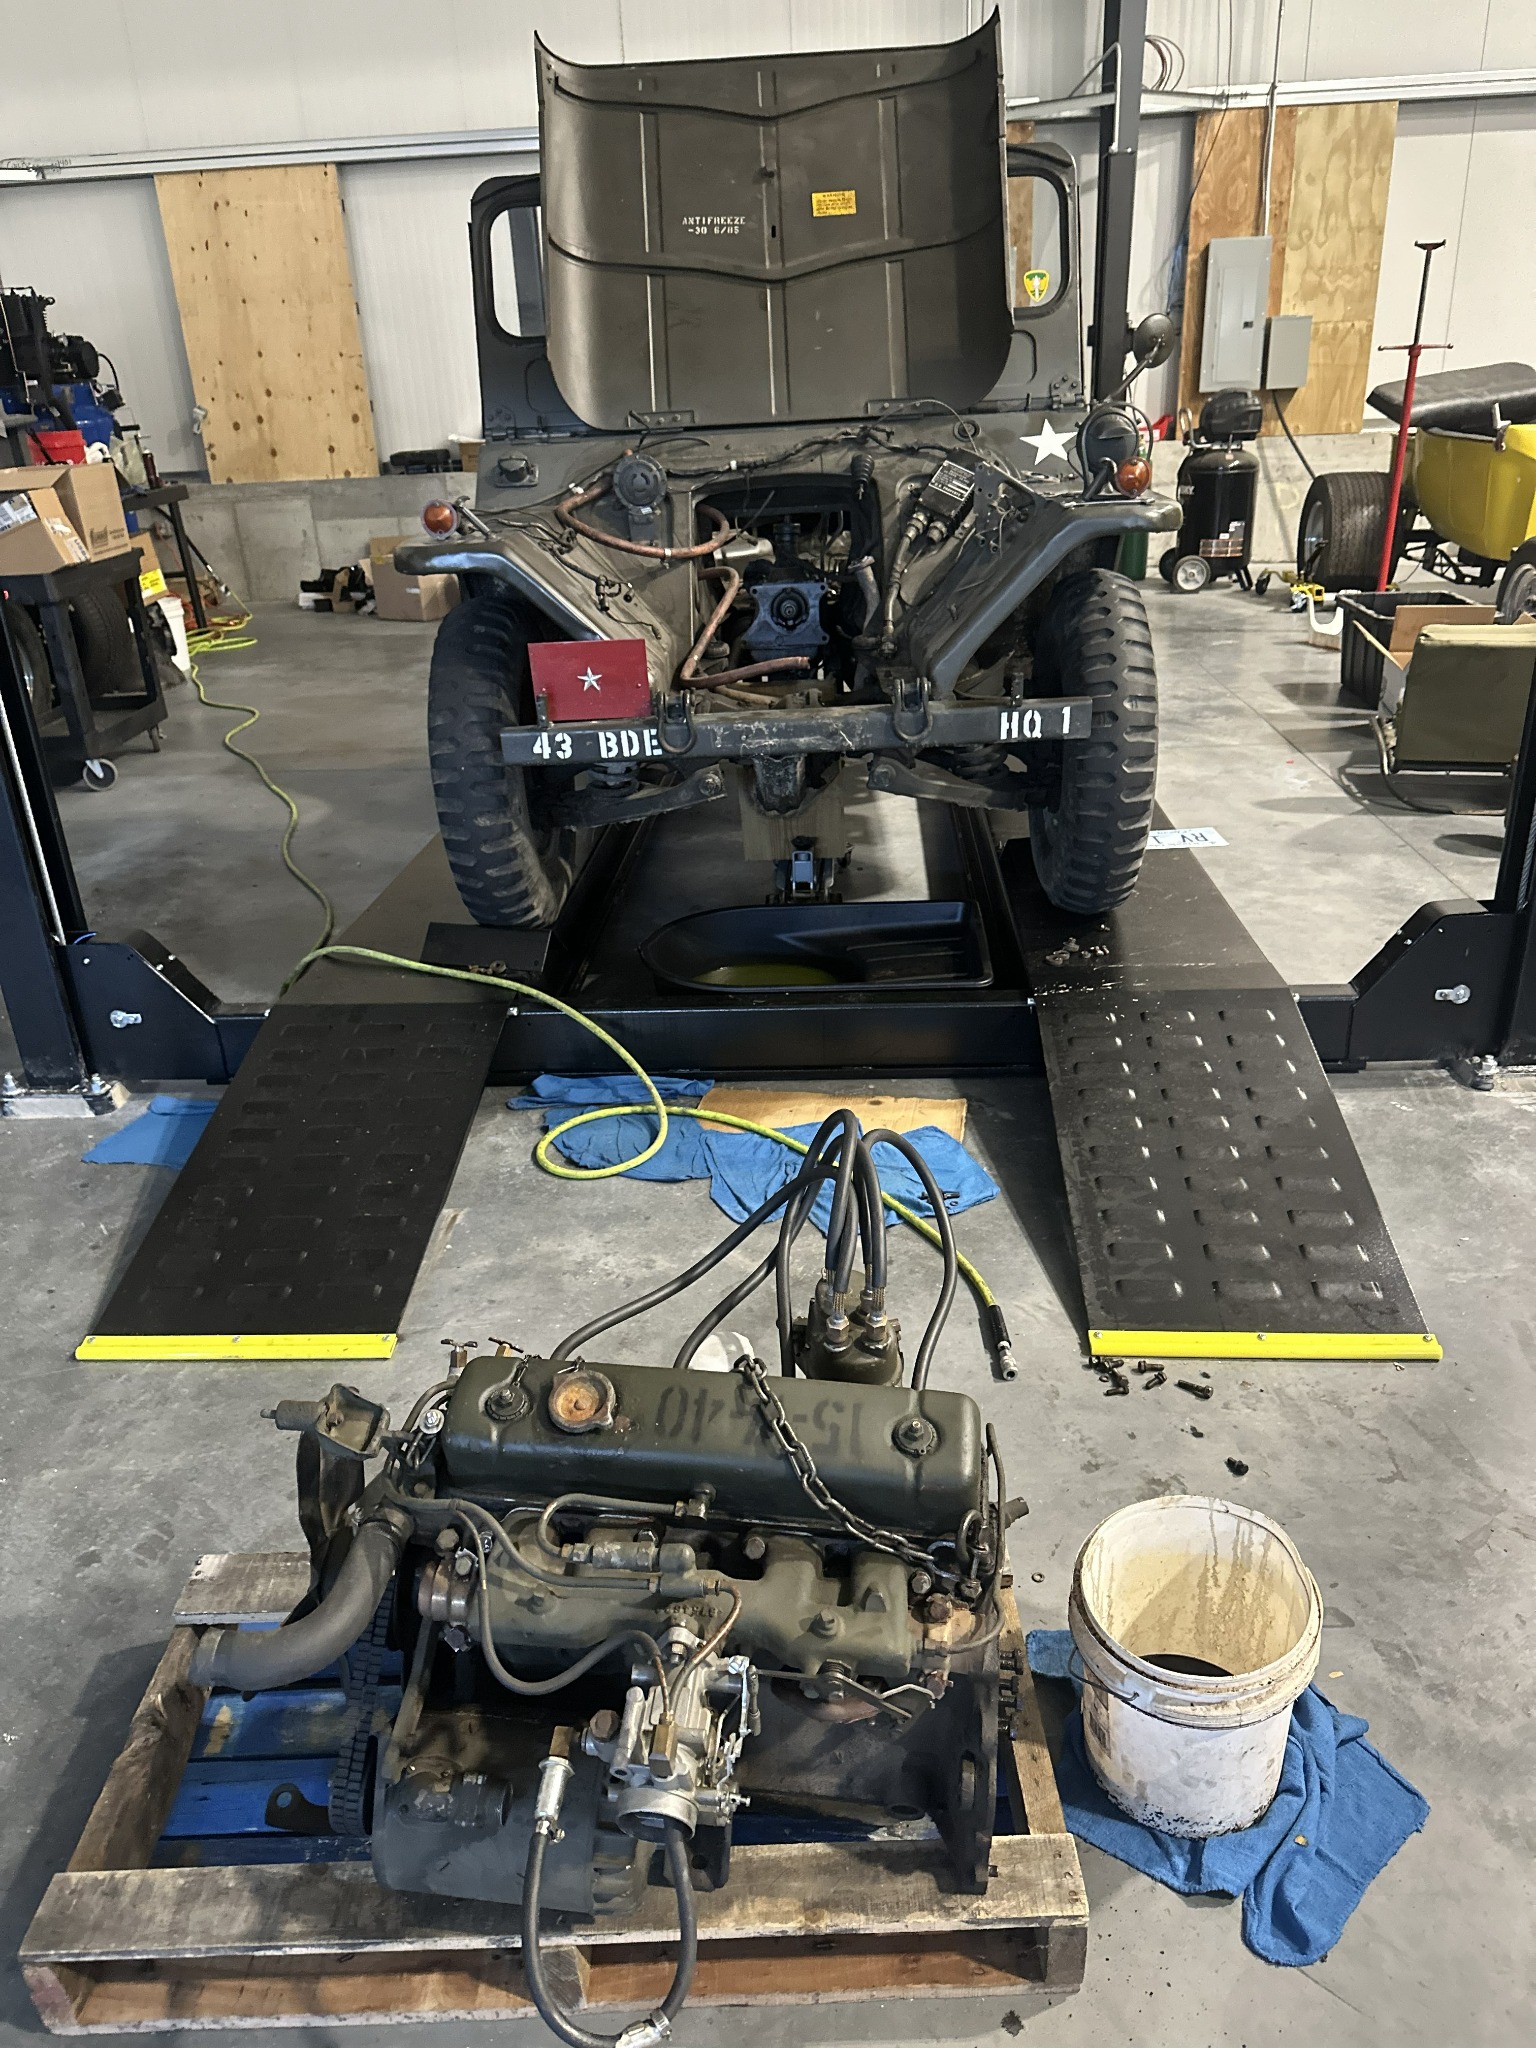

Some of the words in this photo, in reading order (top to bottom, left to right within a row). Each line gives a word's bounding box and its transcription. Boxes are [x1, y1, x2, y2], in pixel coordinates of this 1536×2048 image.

[682, 216, 746, 225] ANTIFREEZE
[687, 226, 708, 235] -30
[1000, 709, 1042, 740] HQ
[1061, 706, 1071, 734] 1
[532, 731, 573, 760] 43
[598, 728, 663, 759] BDE
